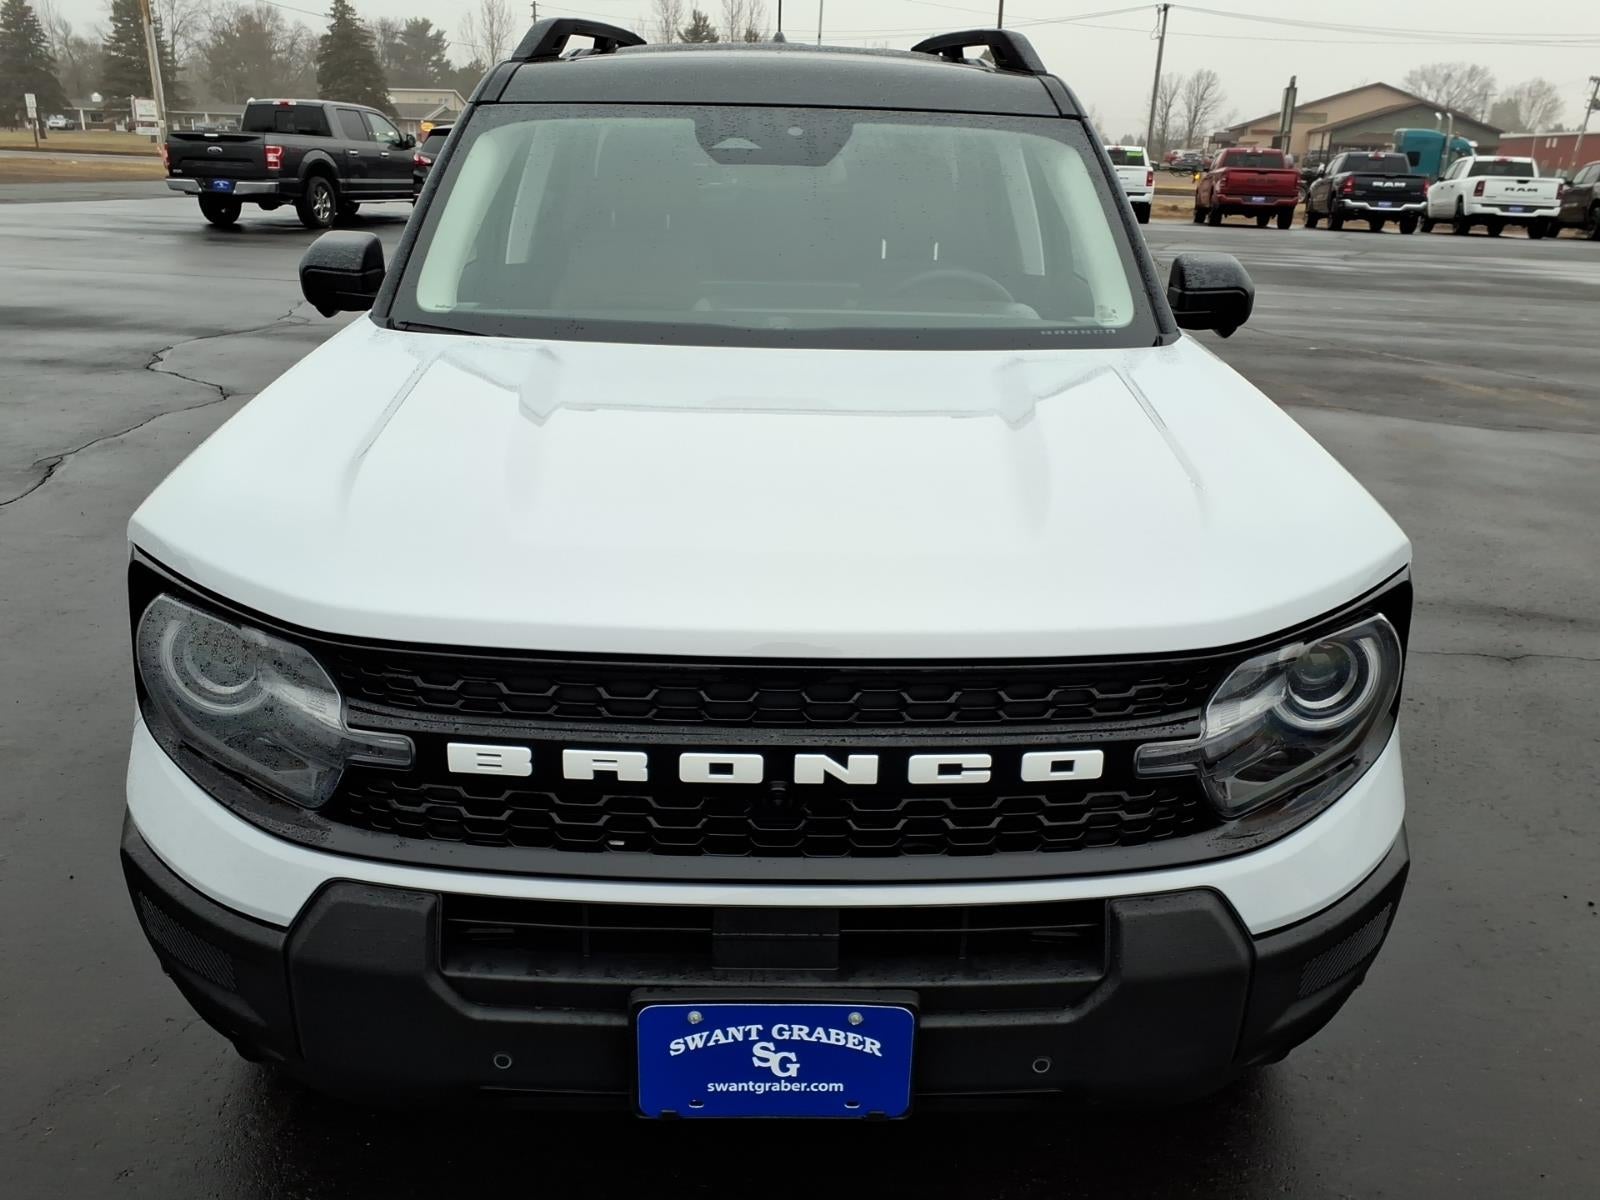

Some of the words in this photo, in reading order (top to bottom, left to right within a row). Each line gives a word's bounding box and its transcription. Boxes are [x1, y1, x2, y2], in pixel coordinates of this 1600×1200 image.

[447, 743, 1104, 784] BRONCO
[669, 1024, 763, 1056] SWANT
[771, 1024, 882, 1056] GRABER
[752, 1042, 800, 1077] SG
[707, 1080, 844, 1094] swantgraber.com
